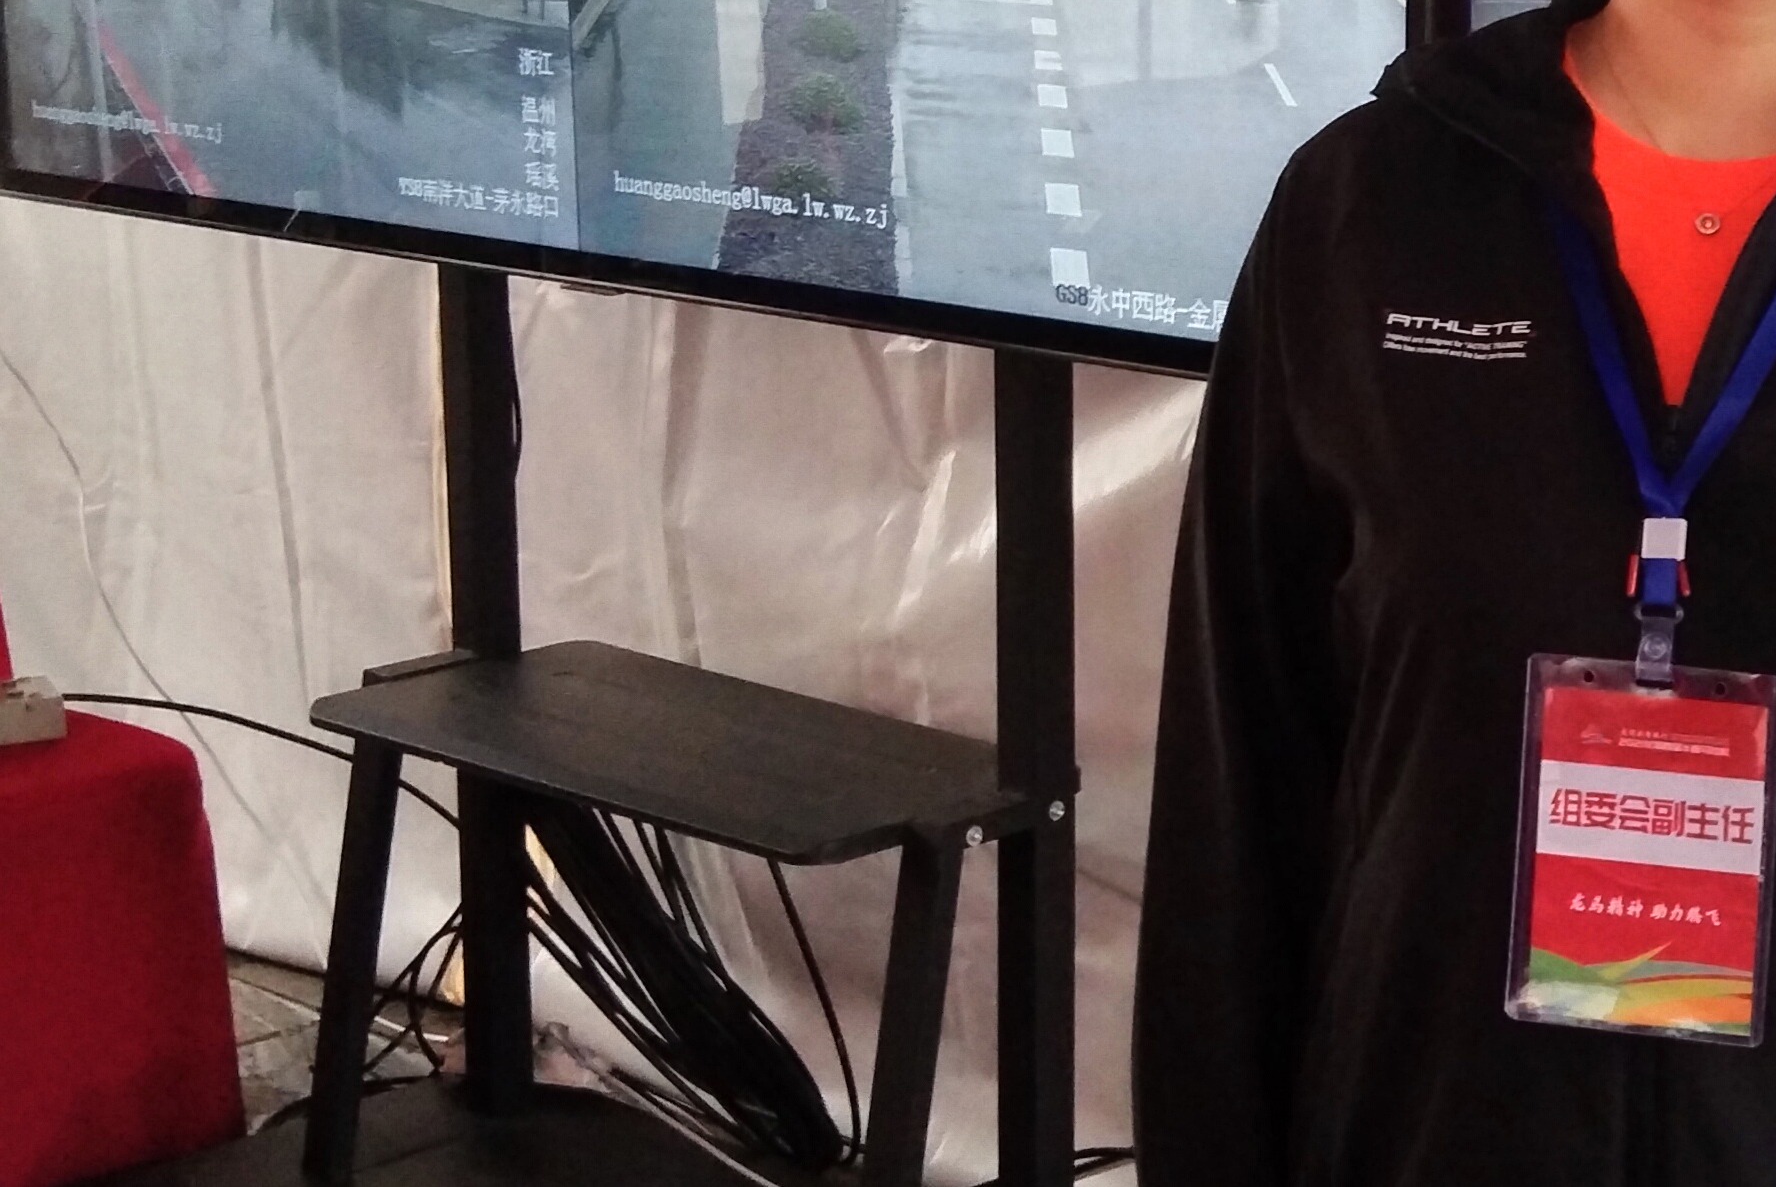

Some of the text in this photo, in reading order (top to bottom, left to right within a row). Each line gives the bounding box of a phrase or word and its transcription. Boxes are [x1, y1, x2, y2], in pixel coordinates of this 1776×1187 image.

[518, 47, 555, 76] 浙江
[521, 94, 556, 127] 温州
[1386, 313, 1532, 336] ATHLETE
[1548, 787, 1756, 845] 组委会副主任
[1570, 892, 1722, 926] 龙马精神 助力腾飞
